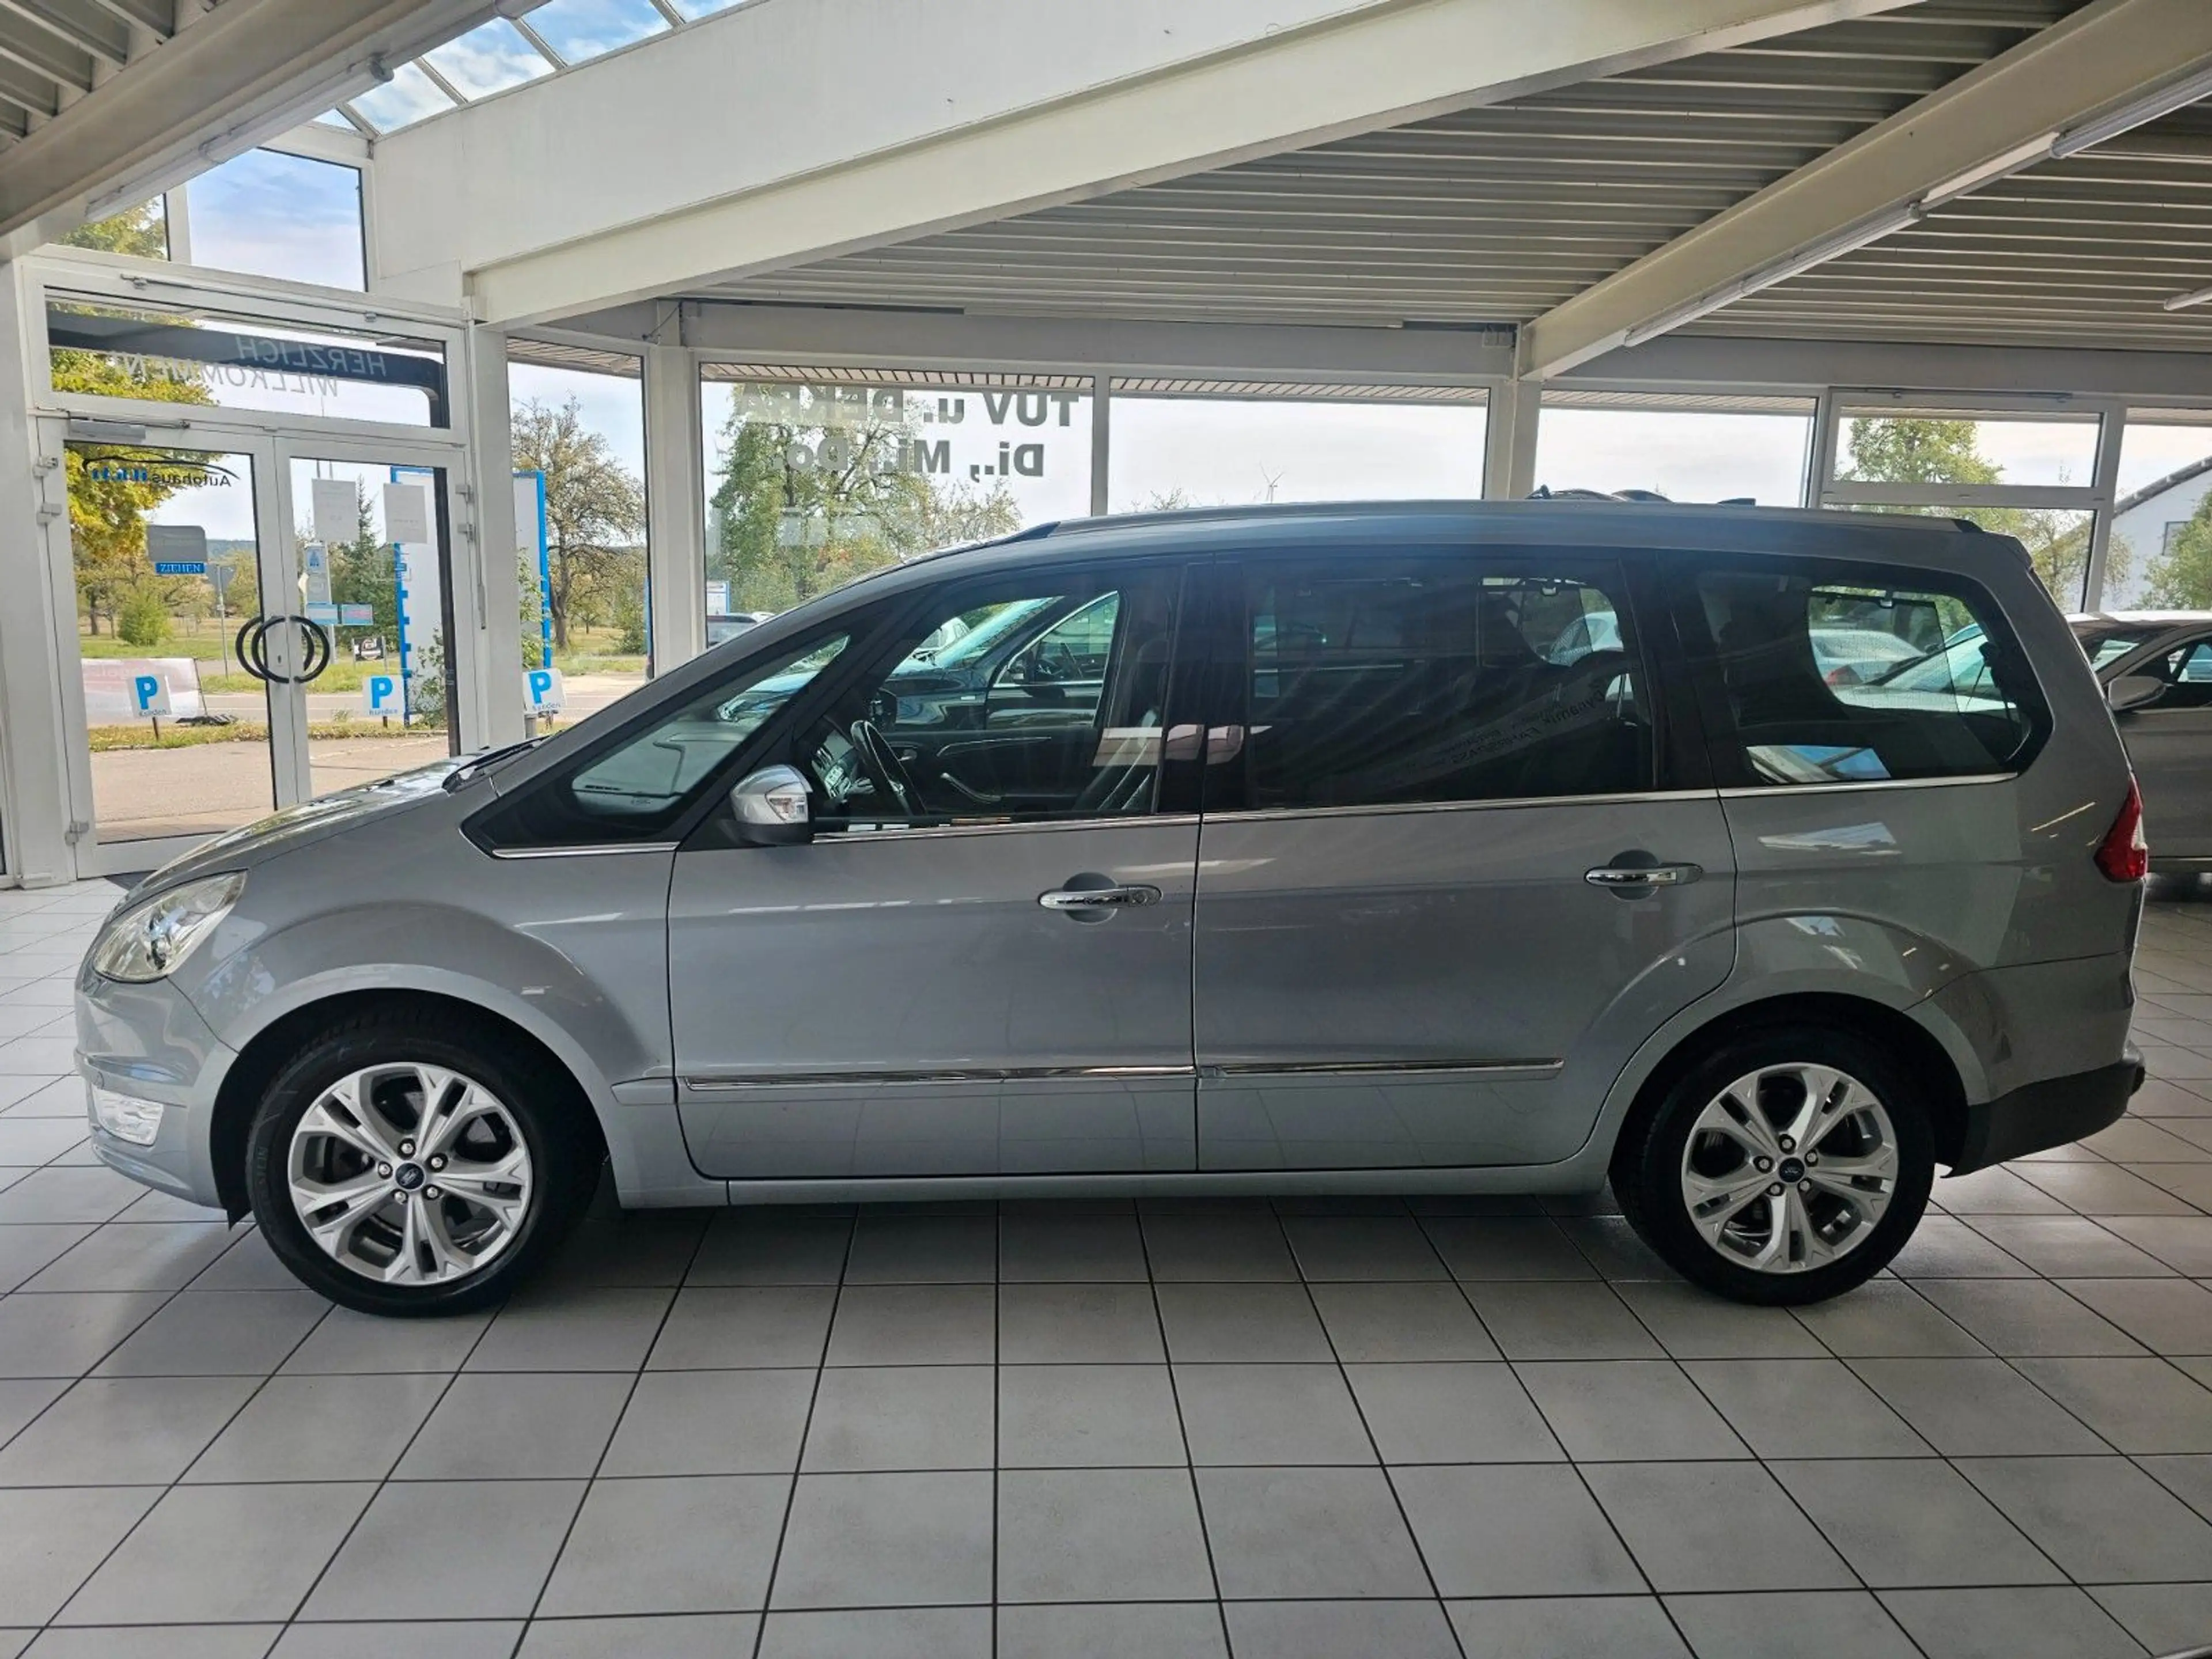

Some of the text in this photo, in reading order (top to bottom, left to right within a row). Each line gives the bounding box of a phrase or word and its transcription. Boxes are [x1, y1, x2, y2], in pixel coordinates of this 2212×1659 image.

[160, 564, 200, 573] ZIEHEN
[135, 676, 158, 710] P
[370, 677, 393, 709] P
[528, 672, 551, 703] P
